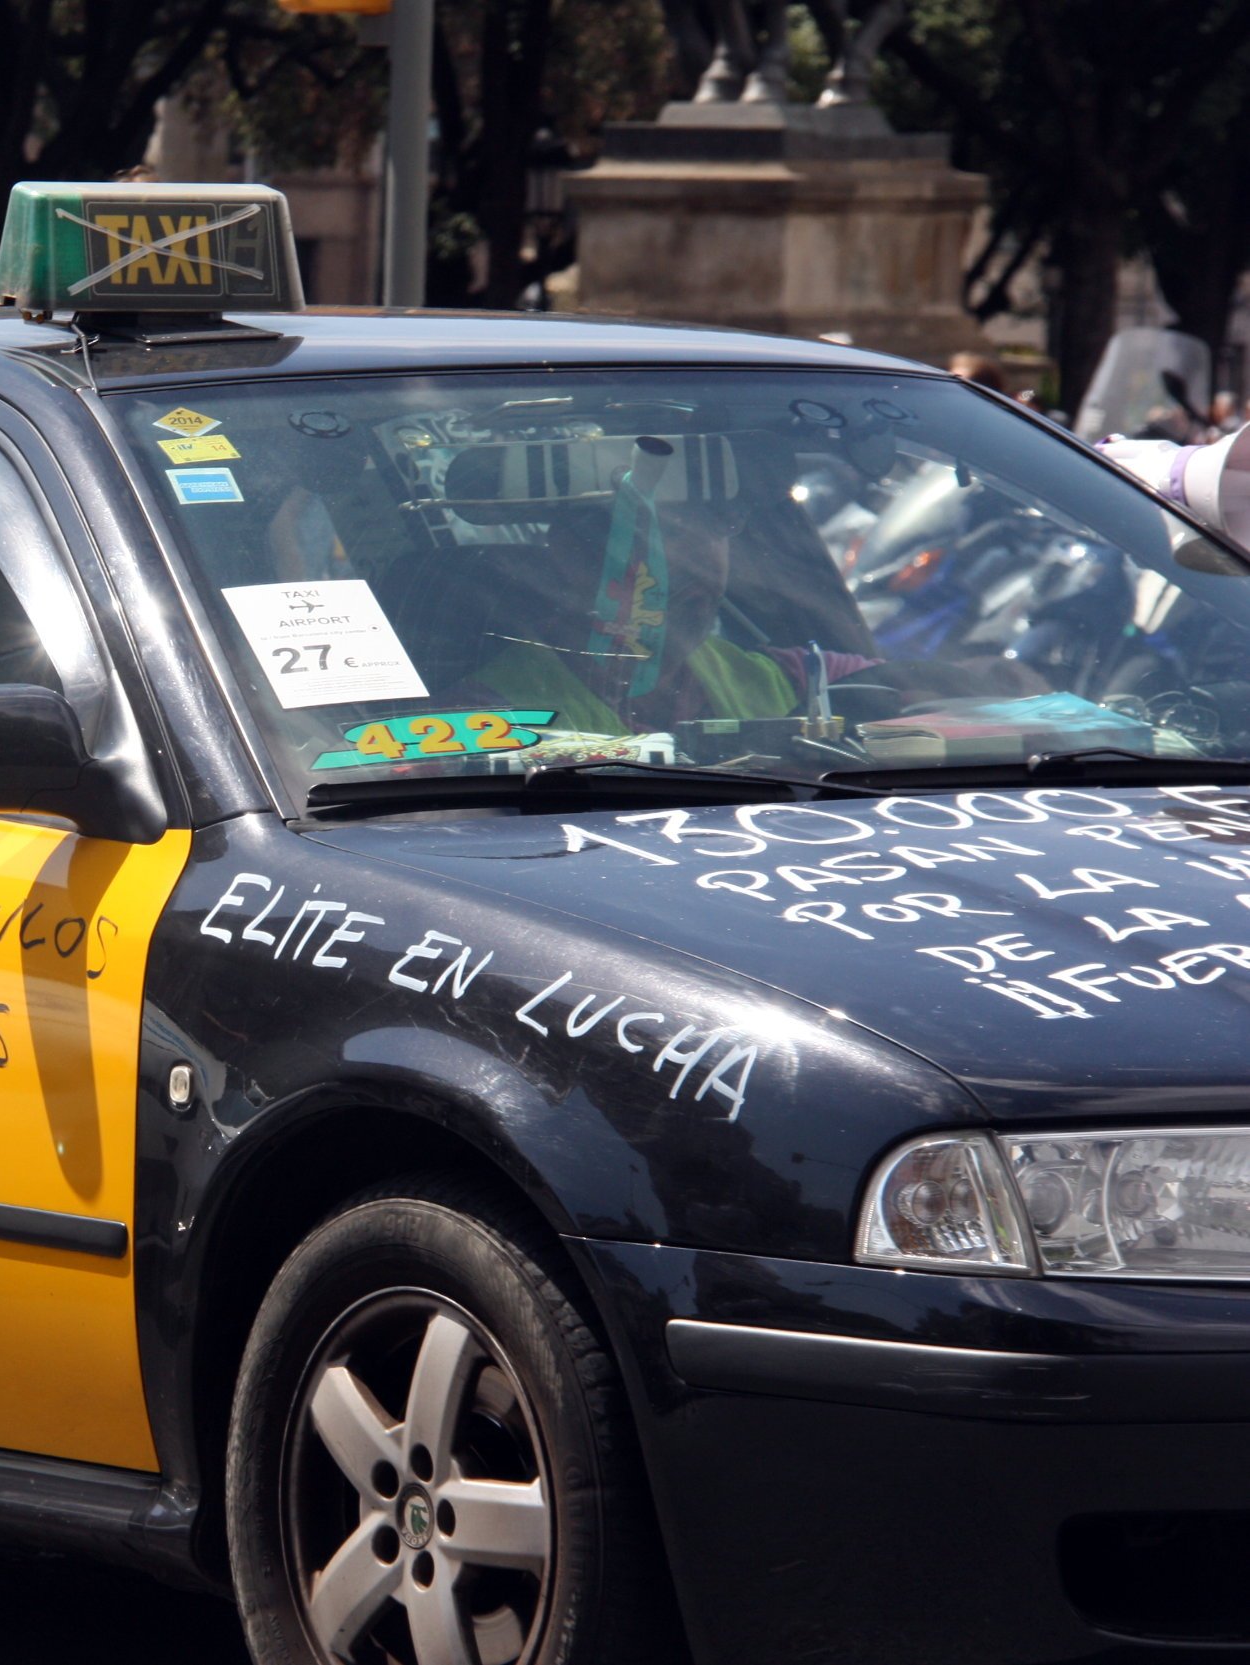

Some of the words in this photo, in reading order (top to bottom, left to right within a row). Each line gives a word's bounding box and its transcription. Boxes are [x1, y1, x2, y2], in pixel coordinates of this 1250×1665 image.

[94, 215, 213, 285] TAXI
[169, 416, 203, 425] 2014
[279, 615, 350, 628] AIRPORT
[281, 590, 320, 599] TAXI
[272, 644, 332, 674] 27
[344, 657, 359, 668] €
[356, 712, 523, 760] 422
[561, 789, 1132, 866] 130.000
[696, 836, 1045, 901] PASAN
[783, 893, 1014, 939] POR
[1015, 868, 1160, 900] LA
[915, 933, 1055, 973] DE
[1084, 908, 1211, 942] LA
[389, 930, 494, 998] EN
[516, 971, 758, 1124] LUCHA
